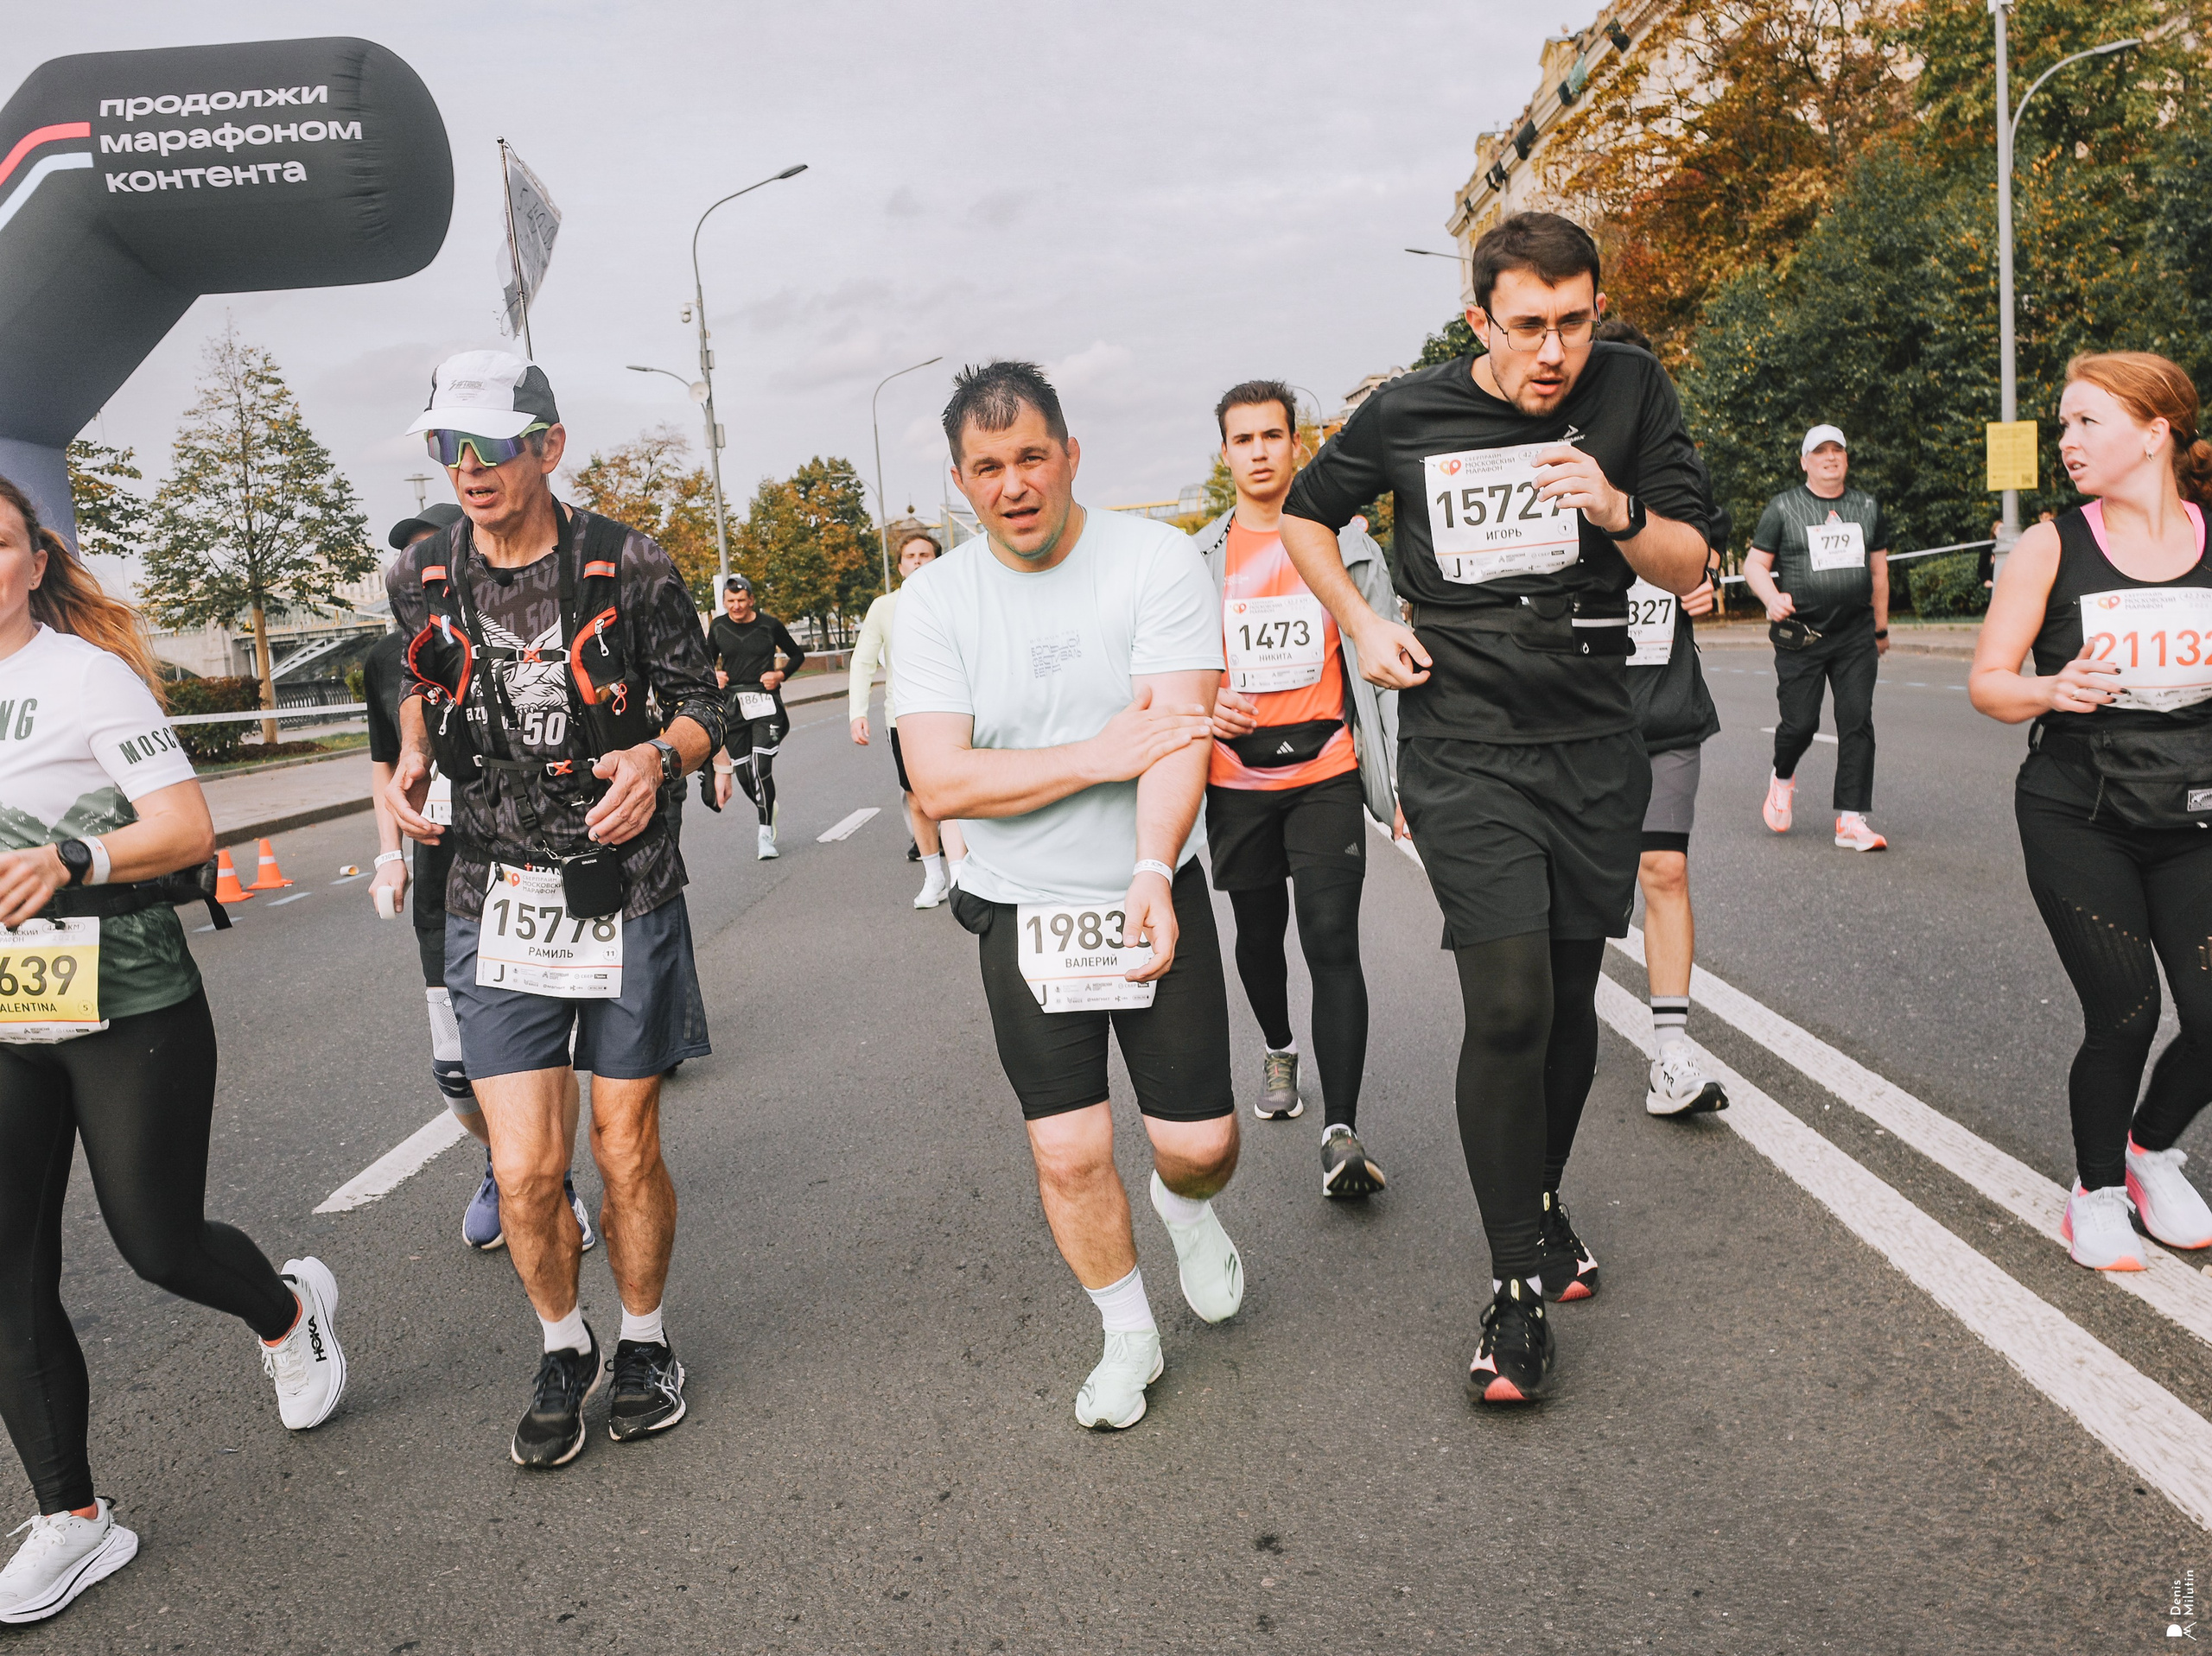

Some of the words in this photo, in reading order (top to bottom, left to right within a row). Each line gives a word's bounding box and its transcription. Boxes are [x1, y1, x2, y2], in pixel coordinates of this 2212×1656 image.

[99, 85, 328, 122] продолжи
[99, 120, 363, 156] марафоном
[105, 161, 308, 193] контента
[1465, 466, 1503, 475] МАРАФОН
[1486, 528, 1522, 542] ИГОРЬ
[1821, 534, 1850, 549] 779
[1453, 558, 1462, 578] J
[1239, 620, 1311, 651] 1473
[1259, 652, 1293, 663] НИКИТА
[1241, 673, 1246, 688] J
[523, 712, 567, 746] 50
[118, 726, 181, 765] MOSC
[522, 880, 563, 889] МОСКОВСКИ
[1027, 910, 1152, 955] 1983
[528, 947, 574, 959] РАМИЛЬ
[1065, 954, 1118, 968] ВАЛЕРИЙ
[493, 964, 505, 983] J
[308, 1315, 327, 1363] HOKA
